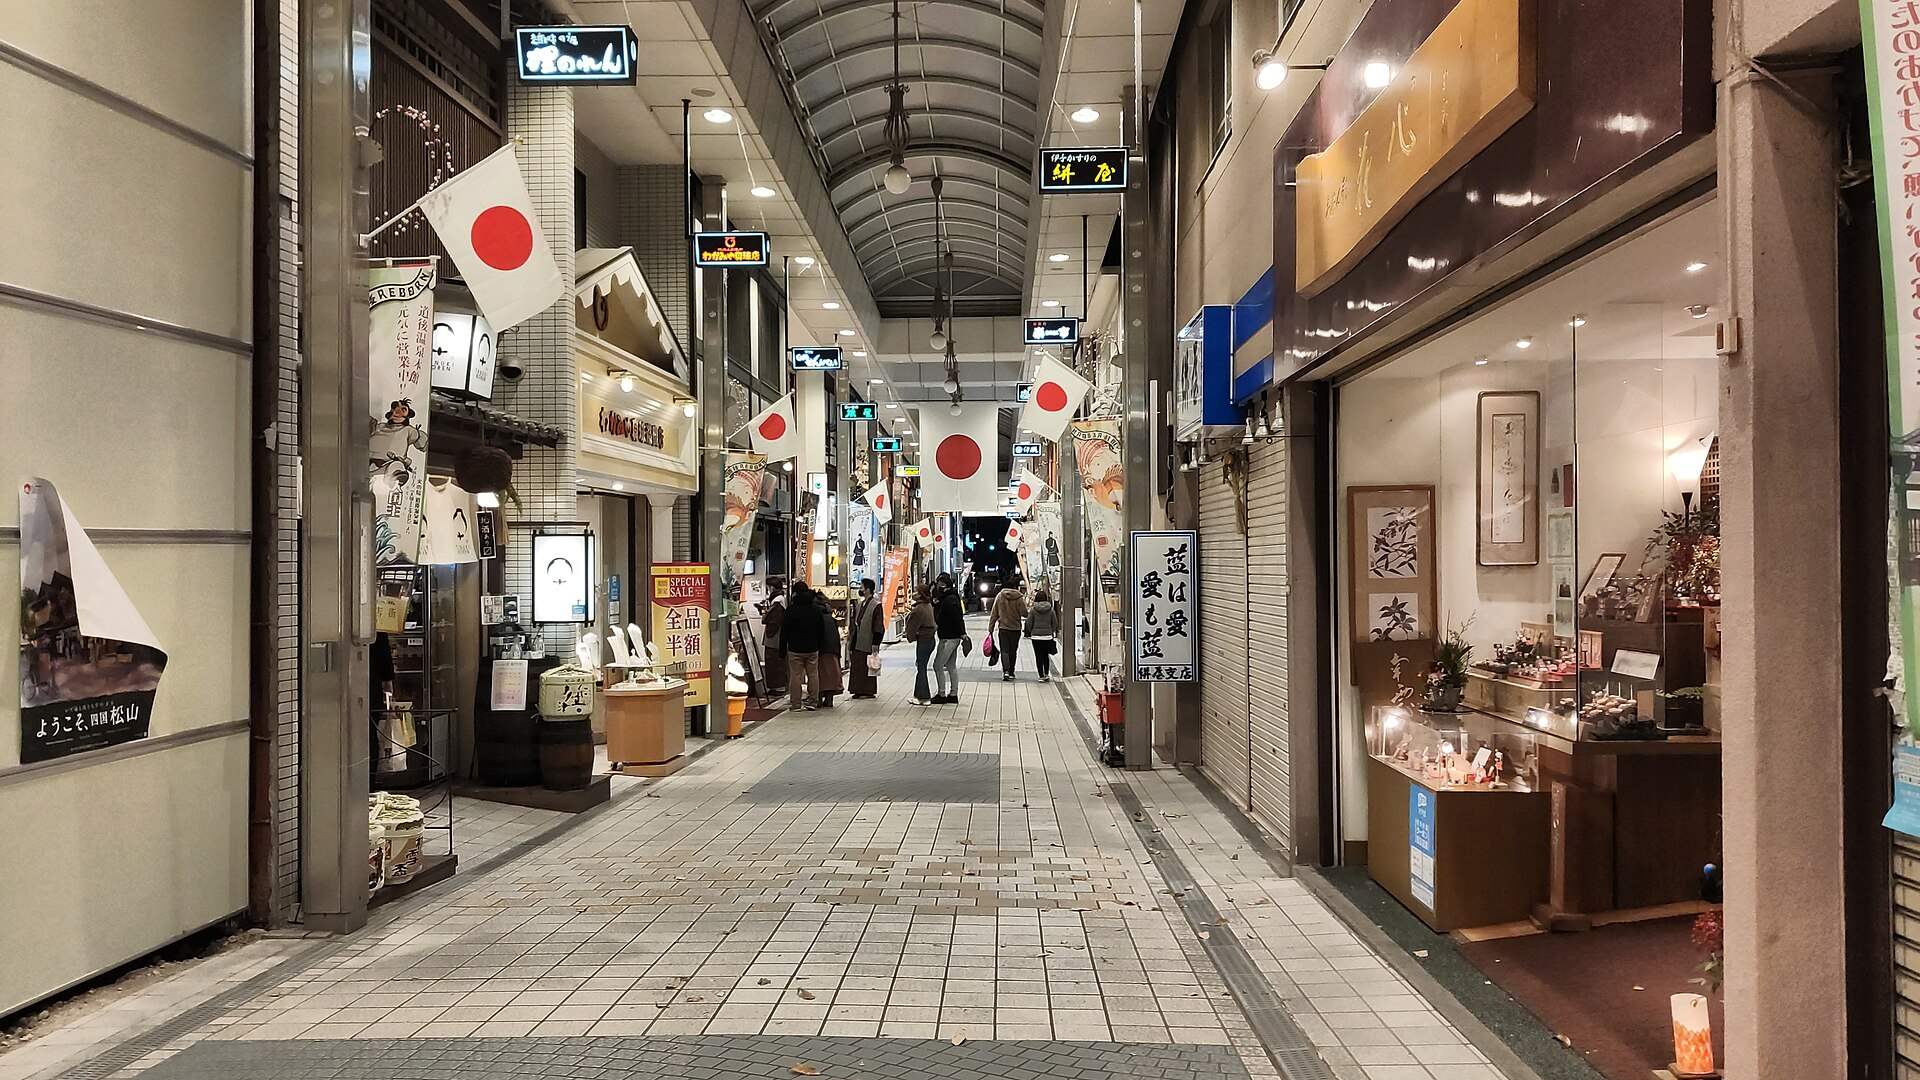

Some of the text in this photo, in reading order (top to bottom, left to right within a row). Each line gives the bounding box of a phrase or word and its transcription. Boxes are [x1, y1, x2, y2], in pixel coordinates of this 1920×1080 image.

[408, 305, 431, 385] 道後温泉本館
[670, 577, 706, 587] SPECIAL
[670, 586, 694, 598] SALE
[1163, 543, 1190, 638] 藍は愛
[665, 607, 701, 631] 全品
[1139, 570, 1164, 659] 愛も藍
[665, 632, 701, 657] 半額
